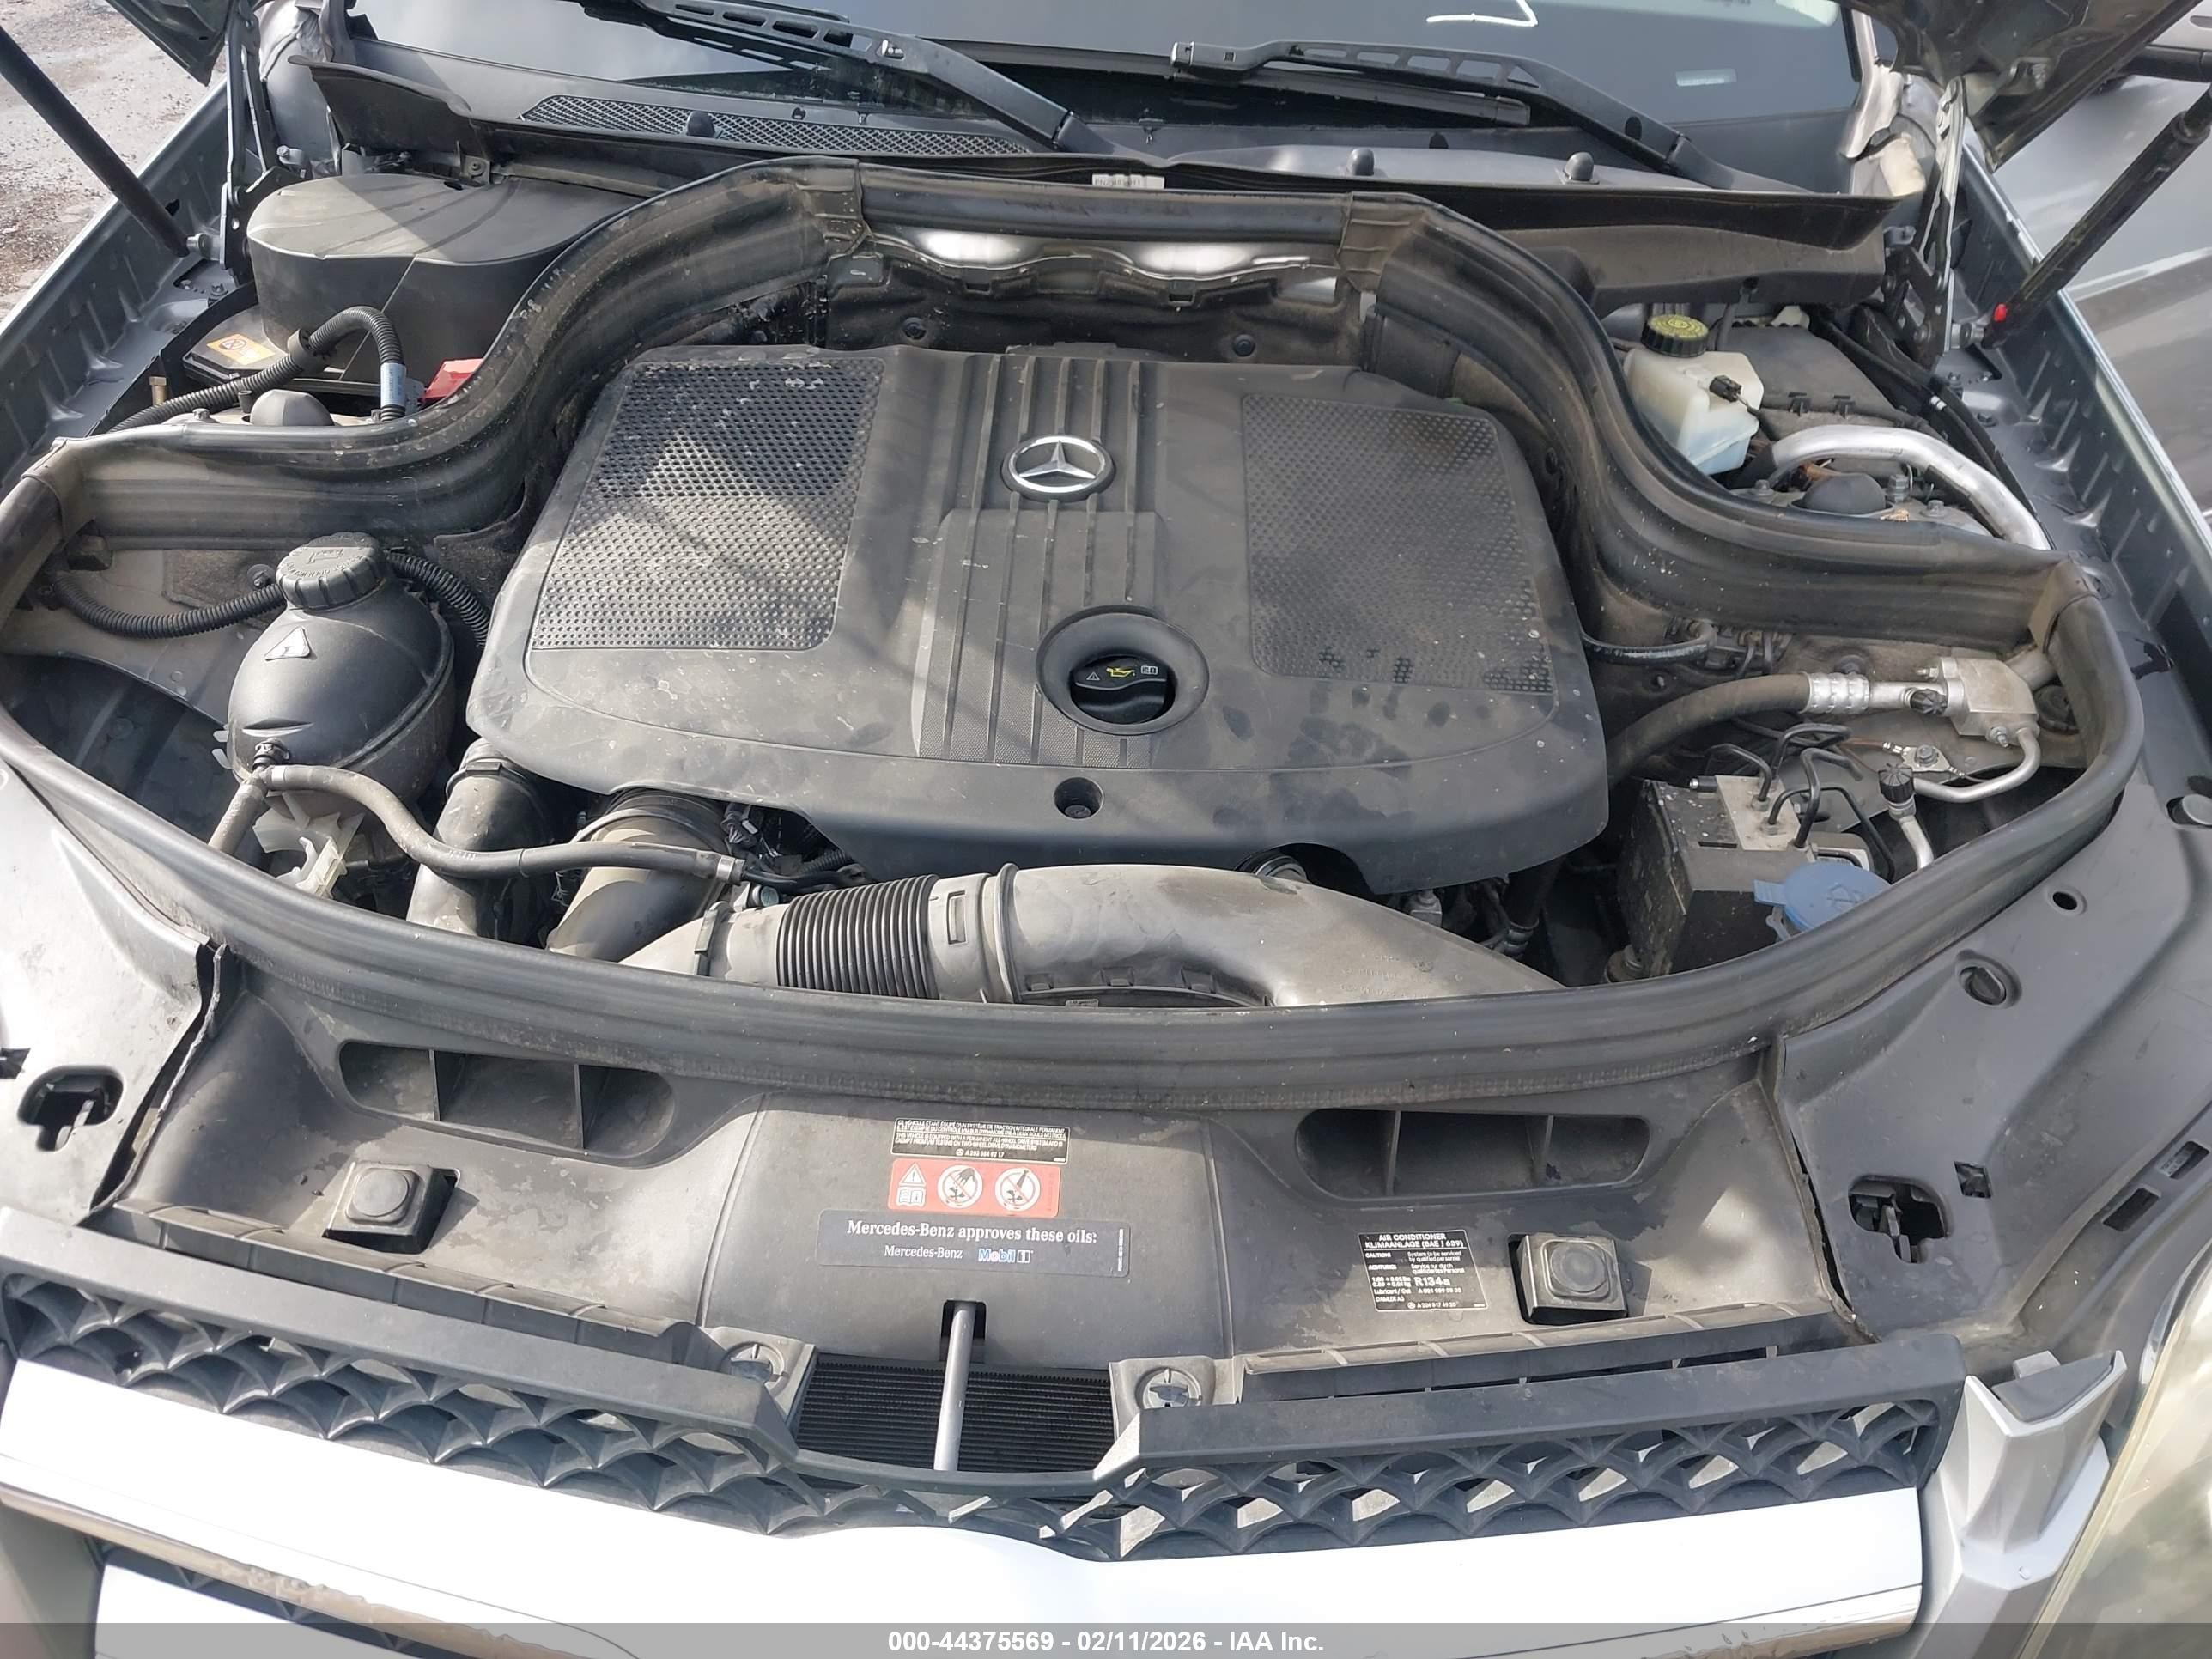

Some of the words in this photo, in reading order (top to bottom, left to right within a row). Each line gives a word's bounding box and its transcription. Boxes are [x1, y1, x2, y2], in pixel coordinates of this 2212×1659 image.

[847, 1219, 955, 1237] Mercedes-Benz
[957, 1227, 1022, 1242] approves
[1025, 1227, 1064, 1242] these
[1067, 1229, 1097, 1244] oils:
[1393, 1232, 1447, 1242] CONDITIONER
[1364, 1240, 1421, 1249] KLIMAANLAGE
[1445, 1238, 1464, 1249] 639)
[884, 1244, 963, 1259] Mercedes-Benz
[978, 1248, 1016, 1263] Mobil
[1413, 1276, 1451, 1287] R134a
